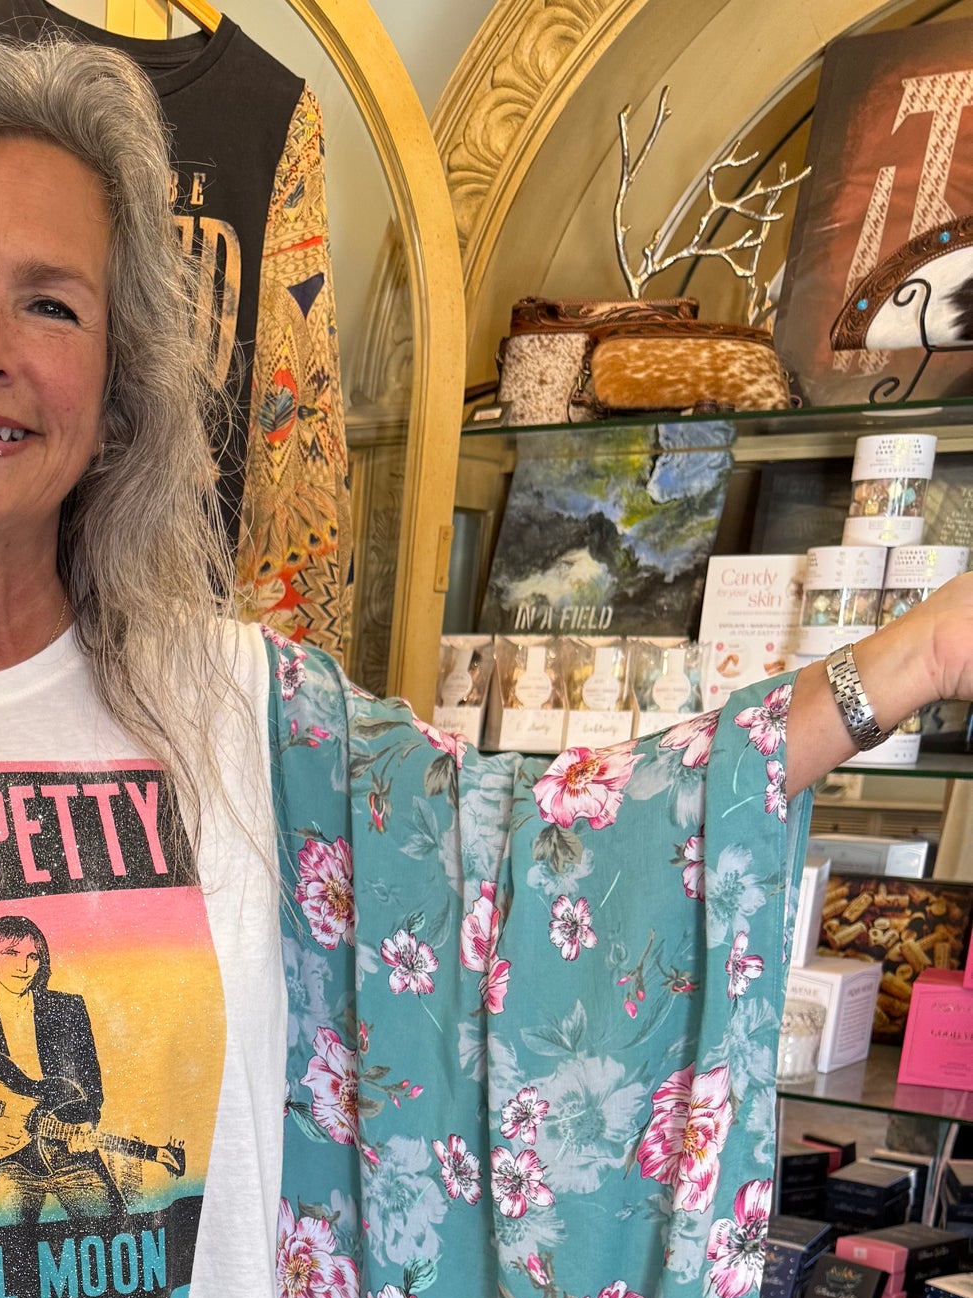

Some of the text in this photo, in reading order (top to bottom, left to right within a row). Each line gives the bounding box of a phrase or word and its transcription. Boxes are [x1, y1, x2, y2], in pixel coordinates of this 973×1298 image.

[721, 568, 777, 590] Candy
[747, 590, 782, 608] skin
[514, 605, 614, 630] IN A FIELD
